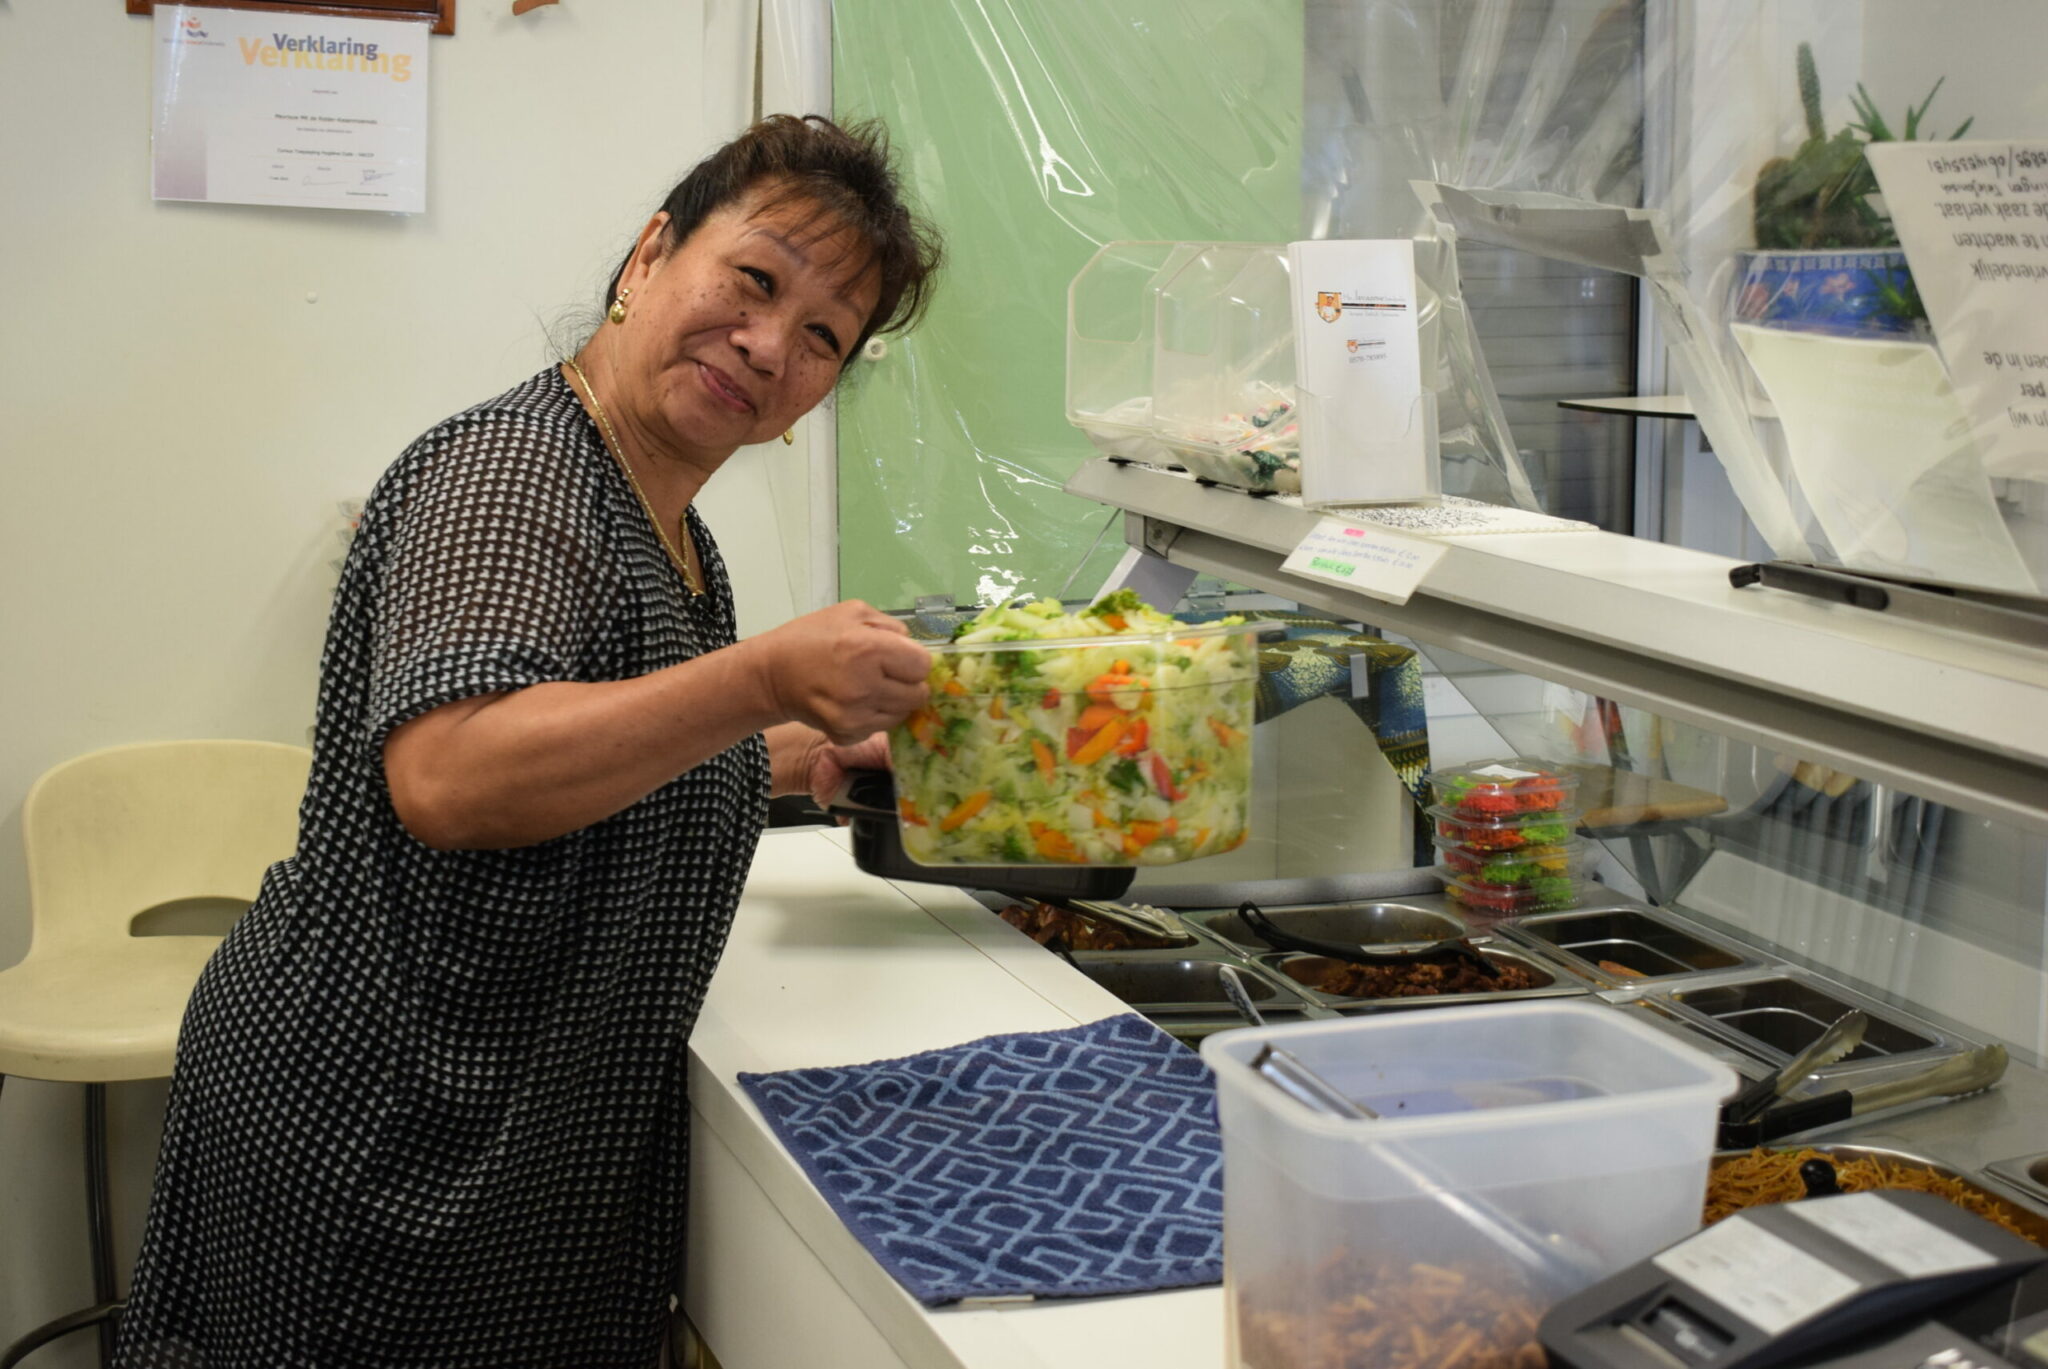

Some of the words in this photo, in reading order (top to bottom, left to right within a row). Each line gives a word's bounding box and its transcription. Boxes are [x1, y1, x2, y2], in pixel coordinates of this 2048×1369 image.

[272, 32, 379, 61] Verklaring
[1934, 202, 1992, 221] verlaat.
[1995, 202, 2031, 221] zaak
[1952, 232, 2019, 251] wachten
[2021, 233, 2040, 250] te
[1982, 351, 2003, 371] de
[2005, 351, 2023, 371] in
[2020, 381, 2047, 398] per
